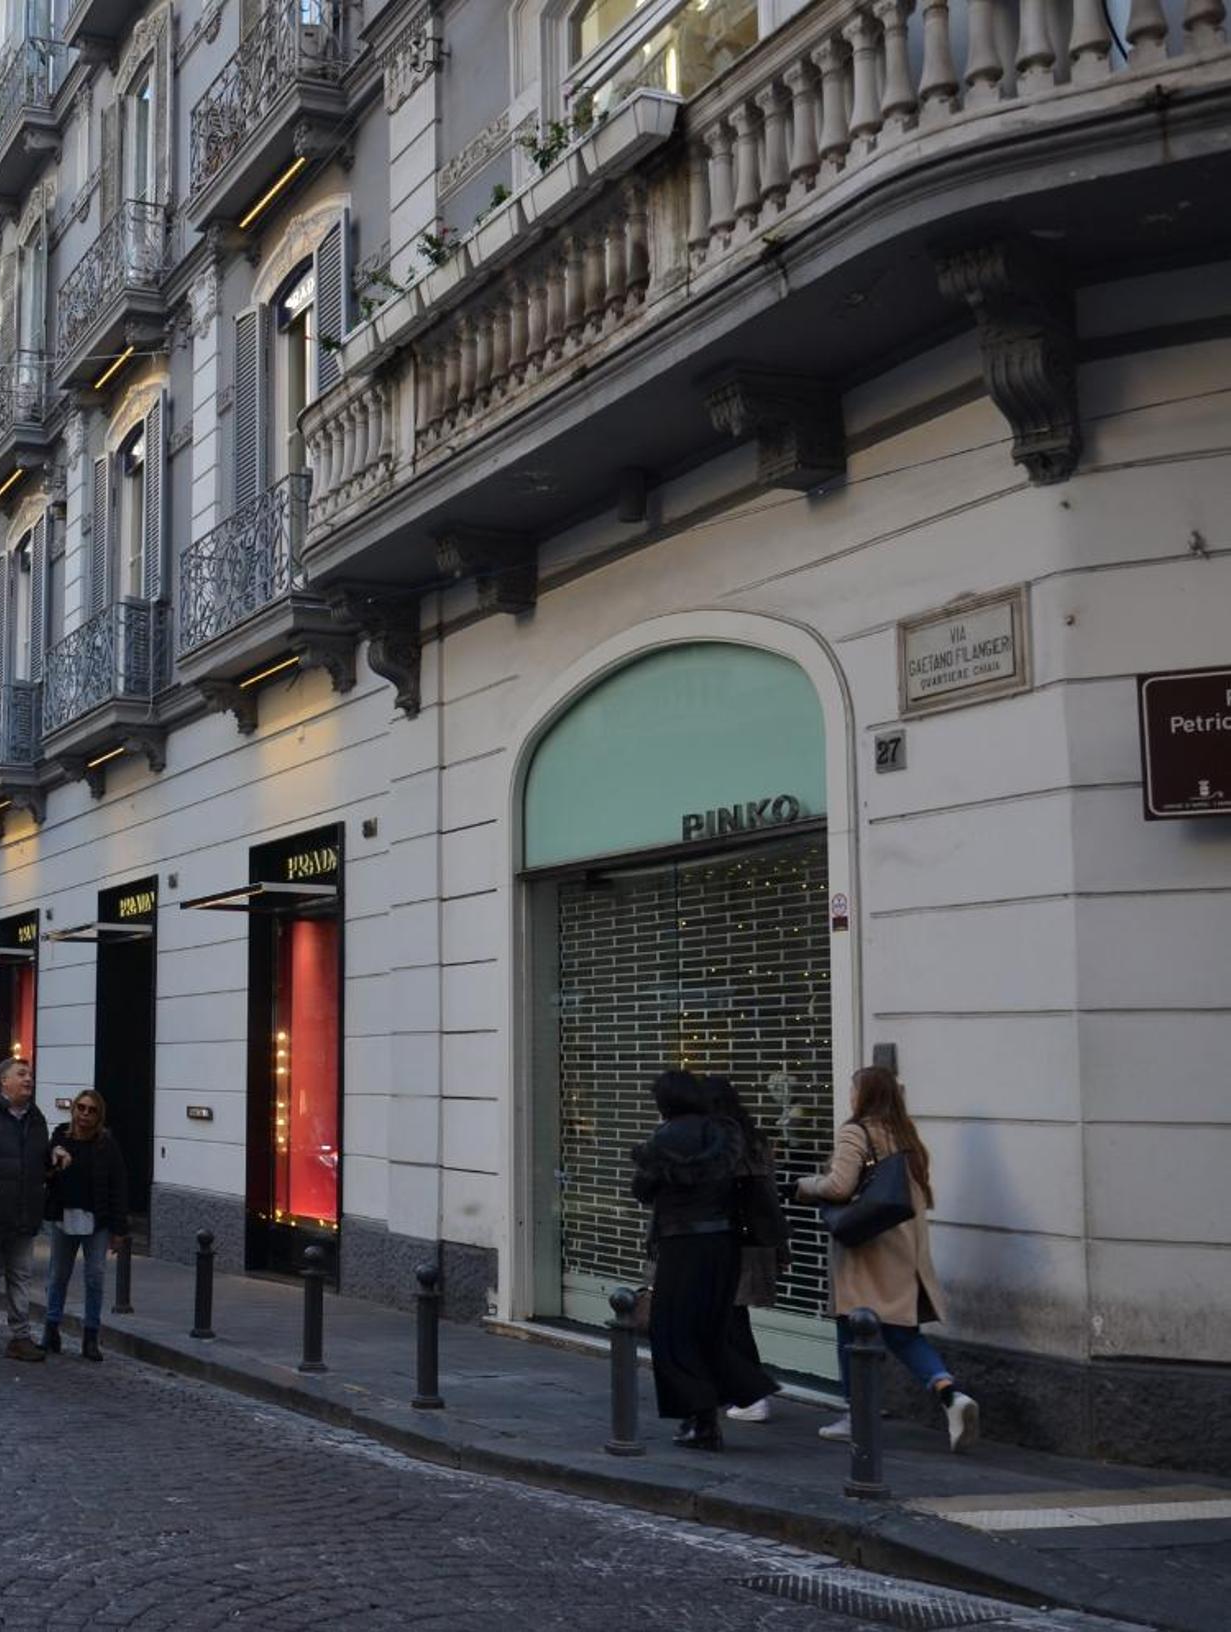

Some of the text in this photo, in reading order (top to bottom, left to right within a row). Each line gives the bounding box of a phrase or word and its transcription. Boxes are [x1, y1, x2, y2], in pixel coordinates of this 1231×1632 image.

[949, 624, 967, 645] VIA
[909, 650, 953, 678] GAETANO
[877, 737, 901, 765] 27
[682, 794, 800, 842] PINKO
